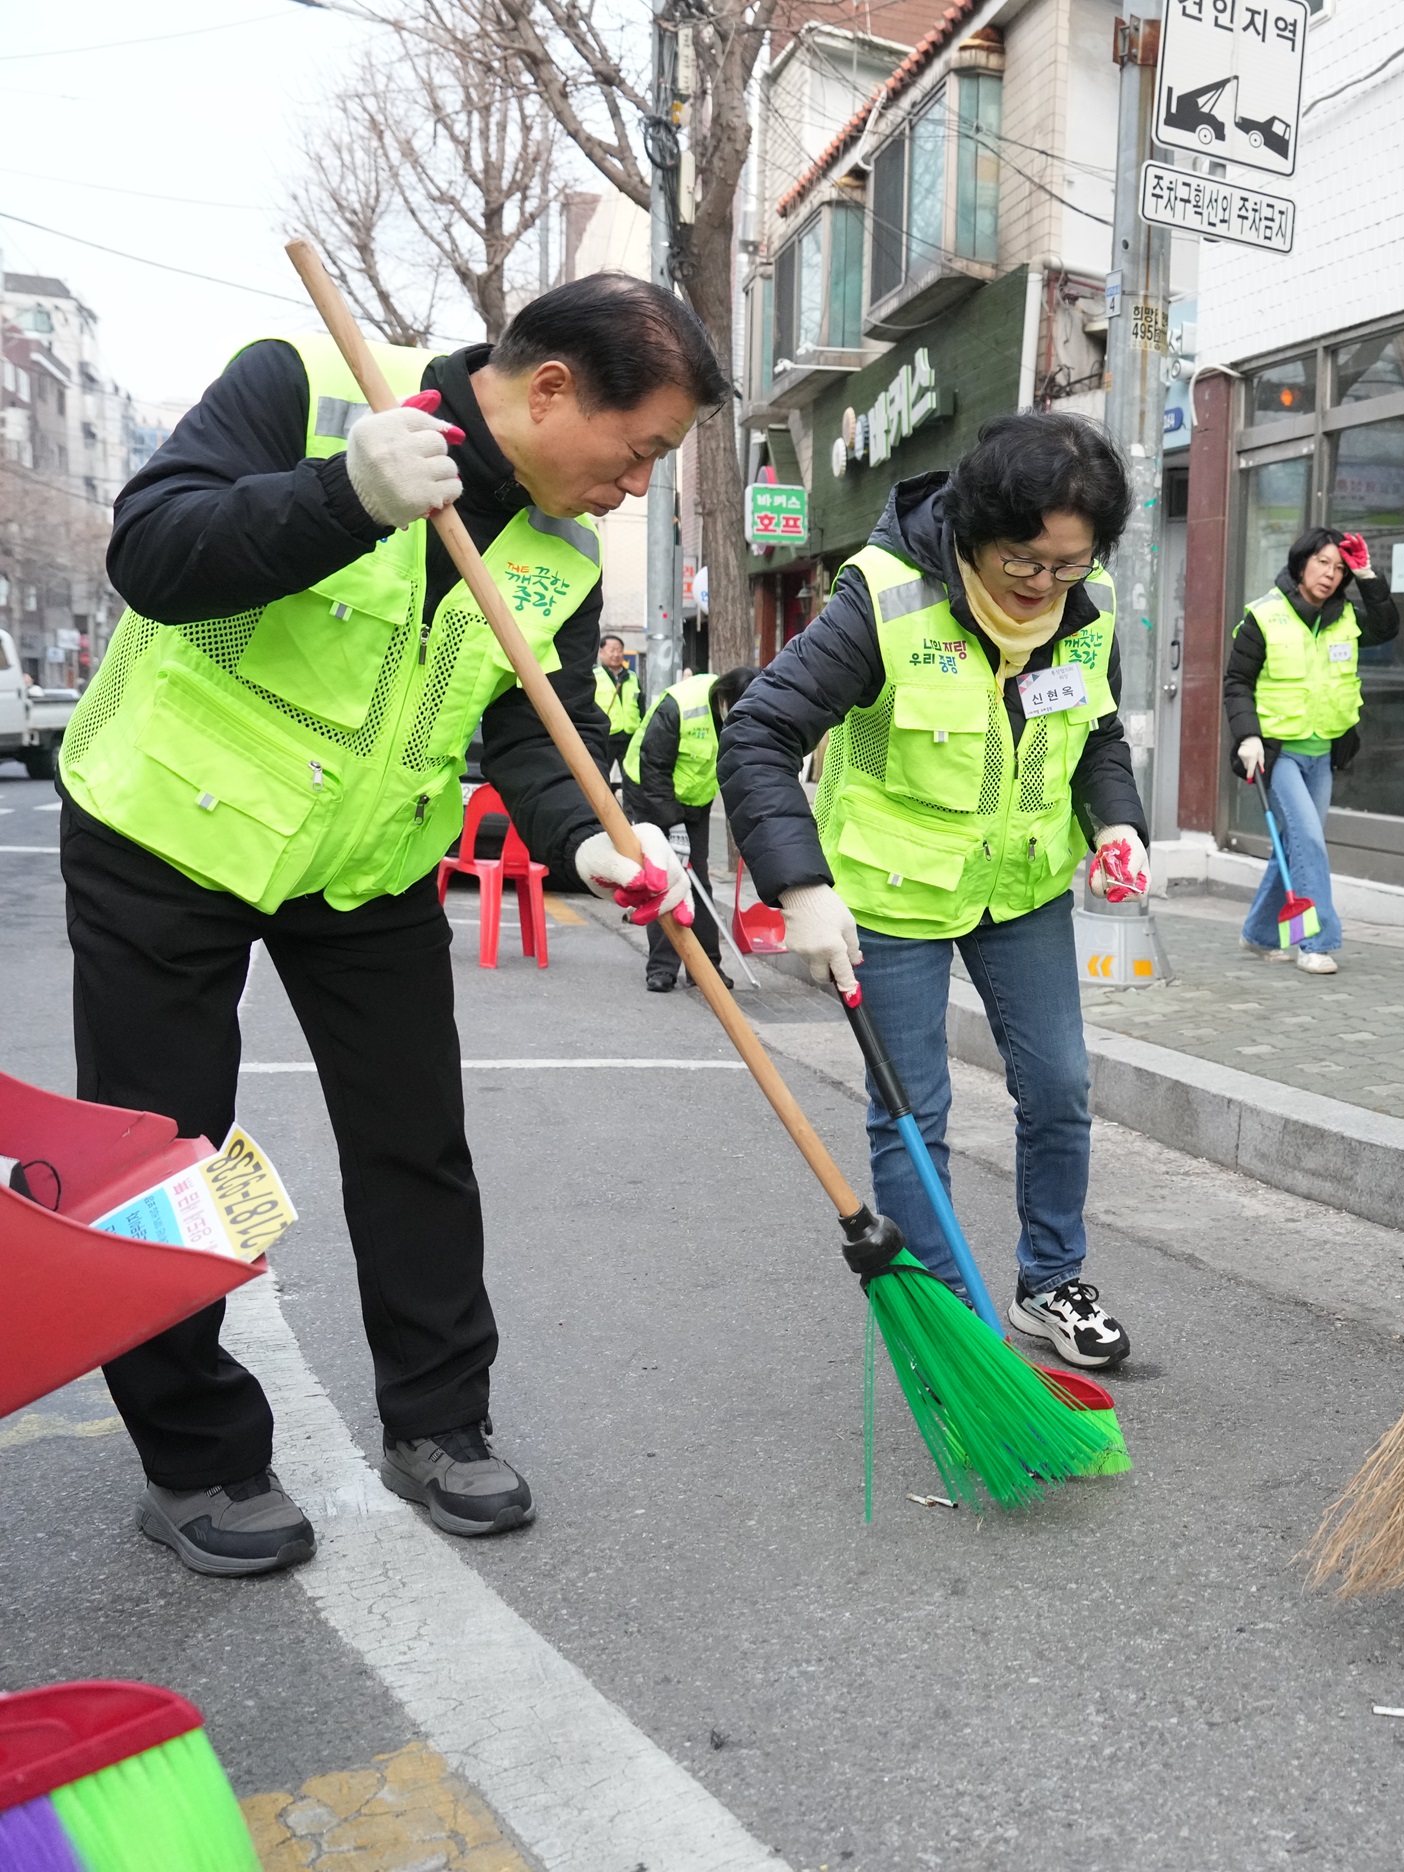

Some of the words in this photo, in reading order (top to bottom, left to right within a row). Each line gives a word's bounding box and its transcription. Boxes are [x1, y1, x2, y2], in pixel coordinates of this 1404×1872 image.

[1151, 175, 1232, 232] 주차구획선외
[1237, 196, 1288, 245] 주차금지
[1109, 297, 1116, 312] 4
[1132, 322, 1154, 341] 495
[868, 347, 936, 467] 바커스
[756, 493, 802, 508] 바커스
[756, 513, 802, 534] 호프
[507, 562, 530, 573] THE
[505, 566, 570, 596] 깨끗한
[512, 586, 557, 616] 중랑
[923, 638, 942, 651] 나의
[942, 640, 967, 660] 자랑
[1064, 628, 1103, 648] 깨끗한
[909, 652, 935, 666] 우리
[938, 655, 958, 674] 중랑
[206, 1138, 290, 1249] 2187-9238
